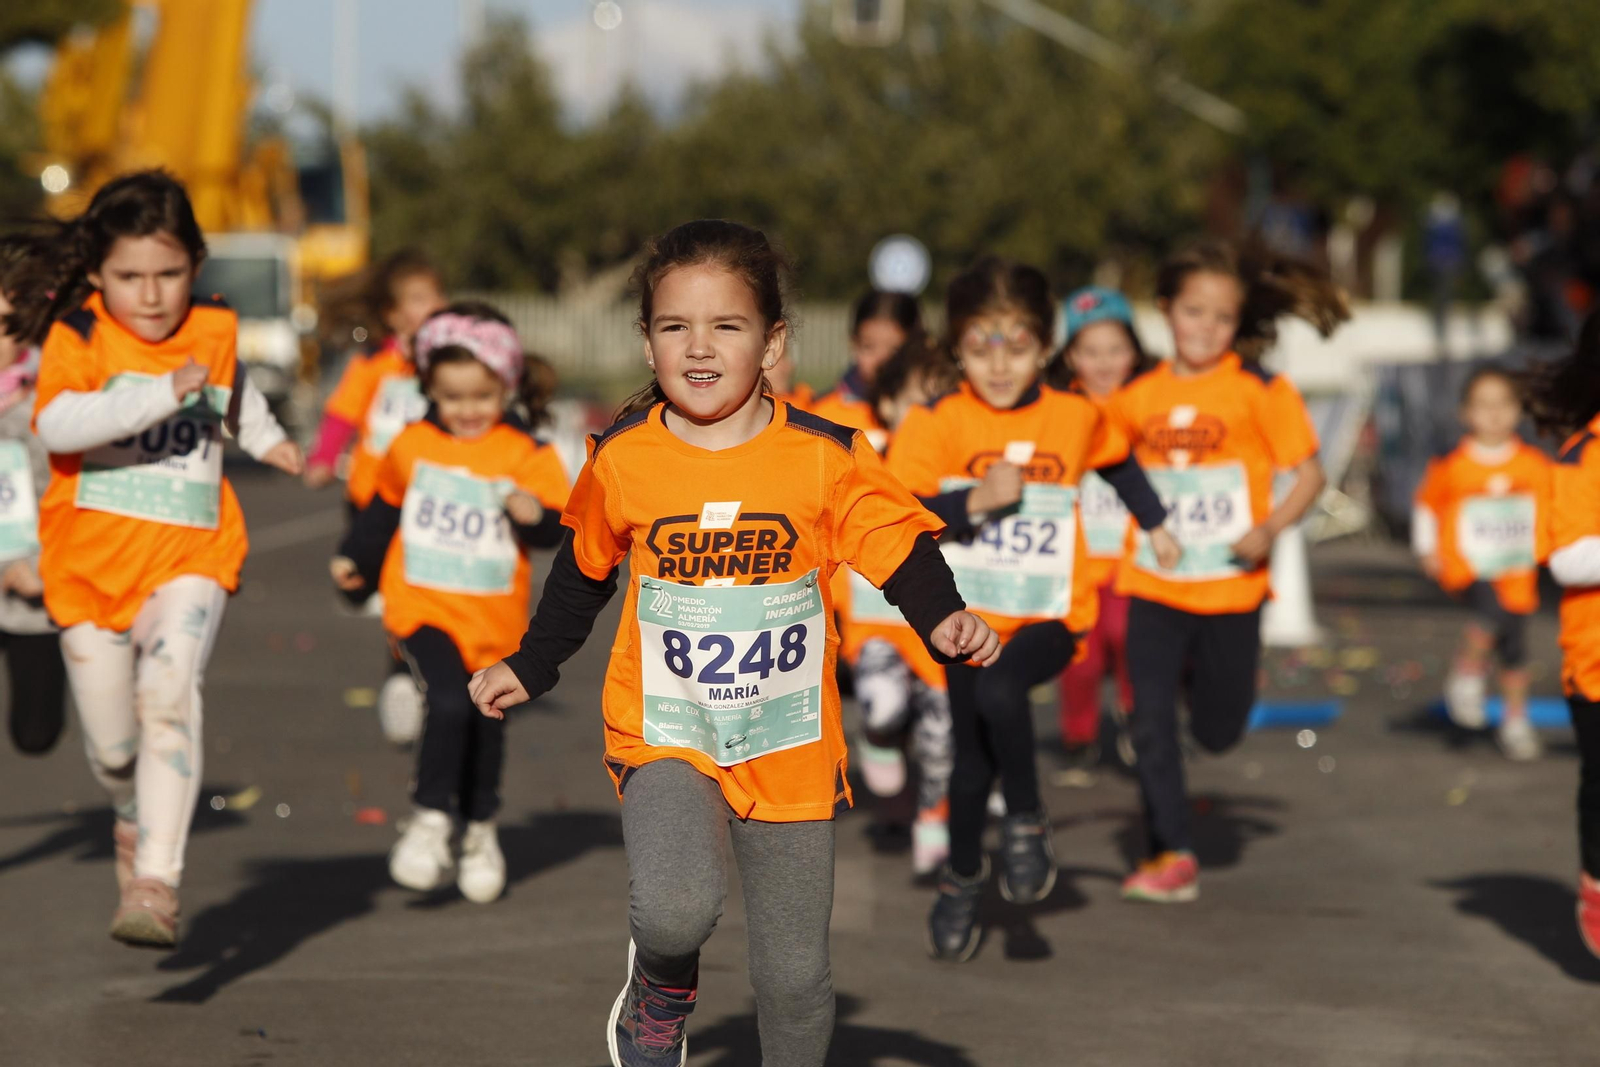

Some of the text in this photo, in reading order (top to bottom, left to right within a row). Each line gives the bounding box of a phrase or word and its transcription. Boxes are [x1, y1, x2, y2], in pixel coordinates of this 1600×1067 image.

[667, 529, 778, 555] SUPER
[658, 551, 792, 578] RUNNER
[677, 596, 706, 606] MEDIO
[762, 587, 813, 607] CARRERA
[677, 604, 722, 614] MARATÓN
[765, 599, 815, 620] INFANTIL
[677, 613, 717, 623] ALMERÍA
[662, 623, 808, 684] 8248
[708, 683, 760, 701] MARÍA
[657, 703, 680, 713] NEXA
[713, 702, 745, 710] GONZALEZ
[658, 722, 683, 731] Blanes
